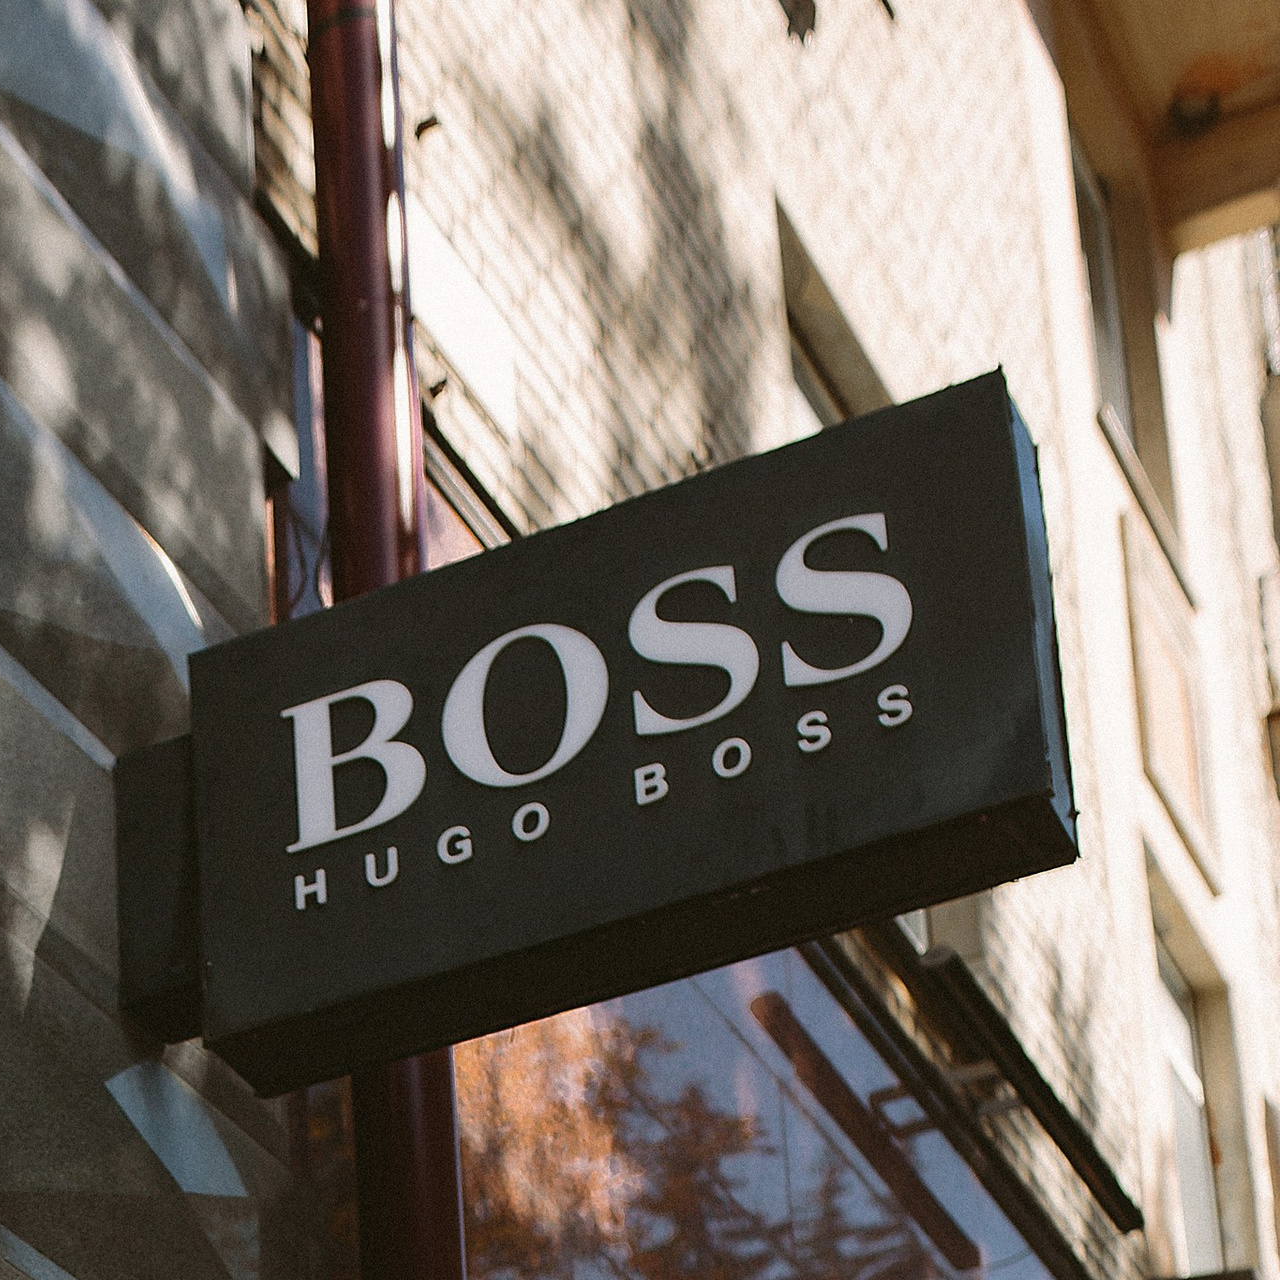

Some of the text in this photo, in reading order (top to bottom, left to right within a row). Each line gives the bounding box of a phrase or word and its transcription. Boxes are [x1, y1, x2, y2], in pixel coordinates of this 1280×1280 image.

[280, 512, 914, 854] BOSS
[293, 683, 914, 911] HUGO BOSS
